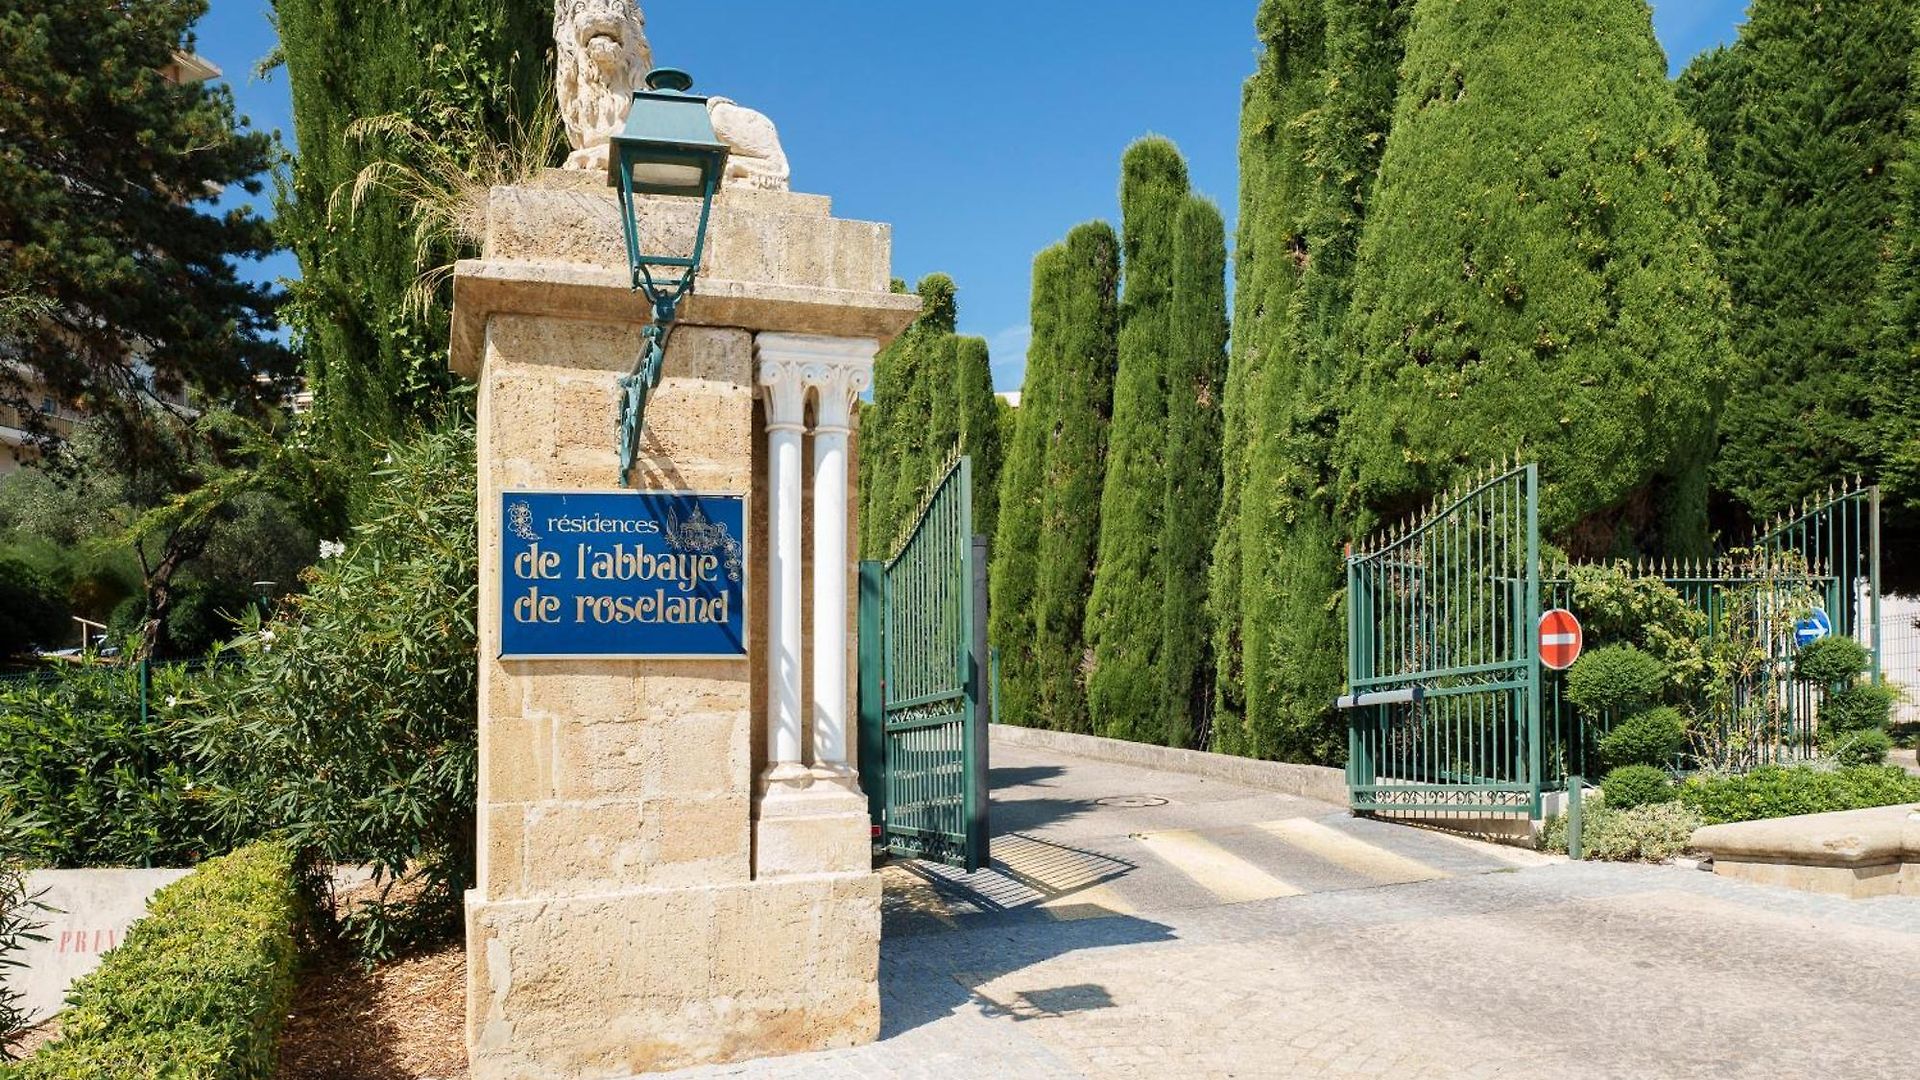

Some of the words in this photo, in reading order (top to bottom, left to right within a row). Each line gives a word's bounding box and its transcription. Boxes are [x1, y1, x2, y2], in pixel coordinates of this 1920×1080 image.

[548, 513, 659, 533] résidences
[514, 542, 561, 580] de
[576, 543, 718, 592] l'abbaye
[513, 586, 561, 624] de
[575, 588, 729, 624] roseland
